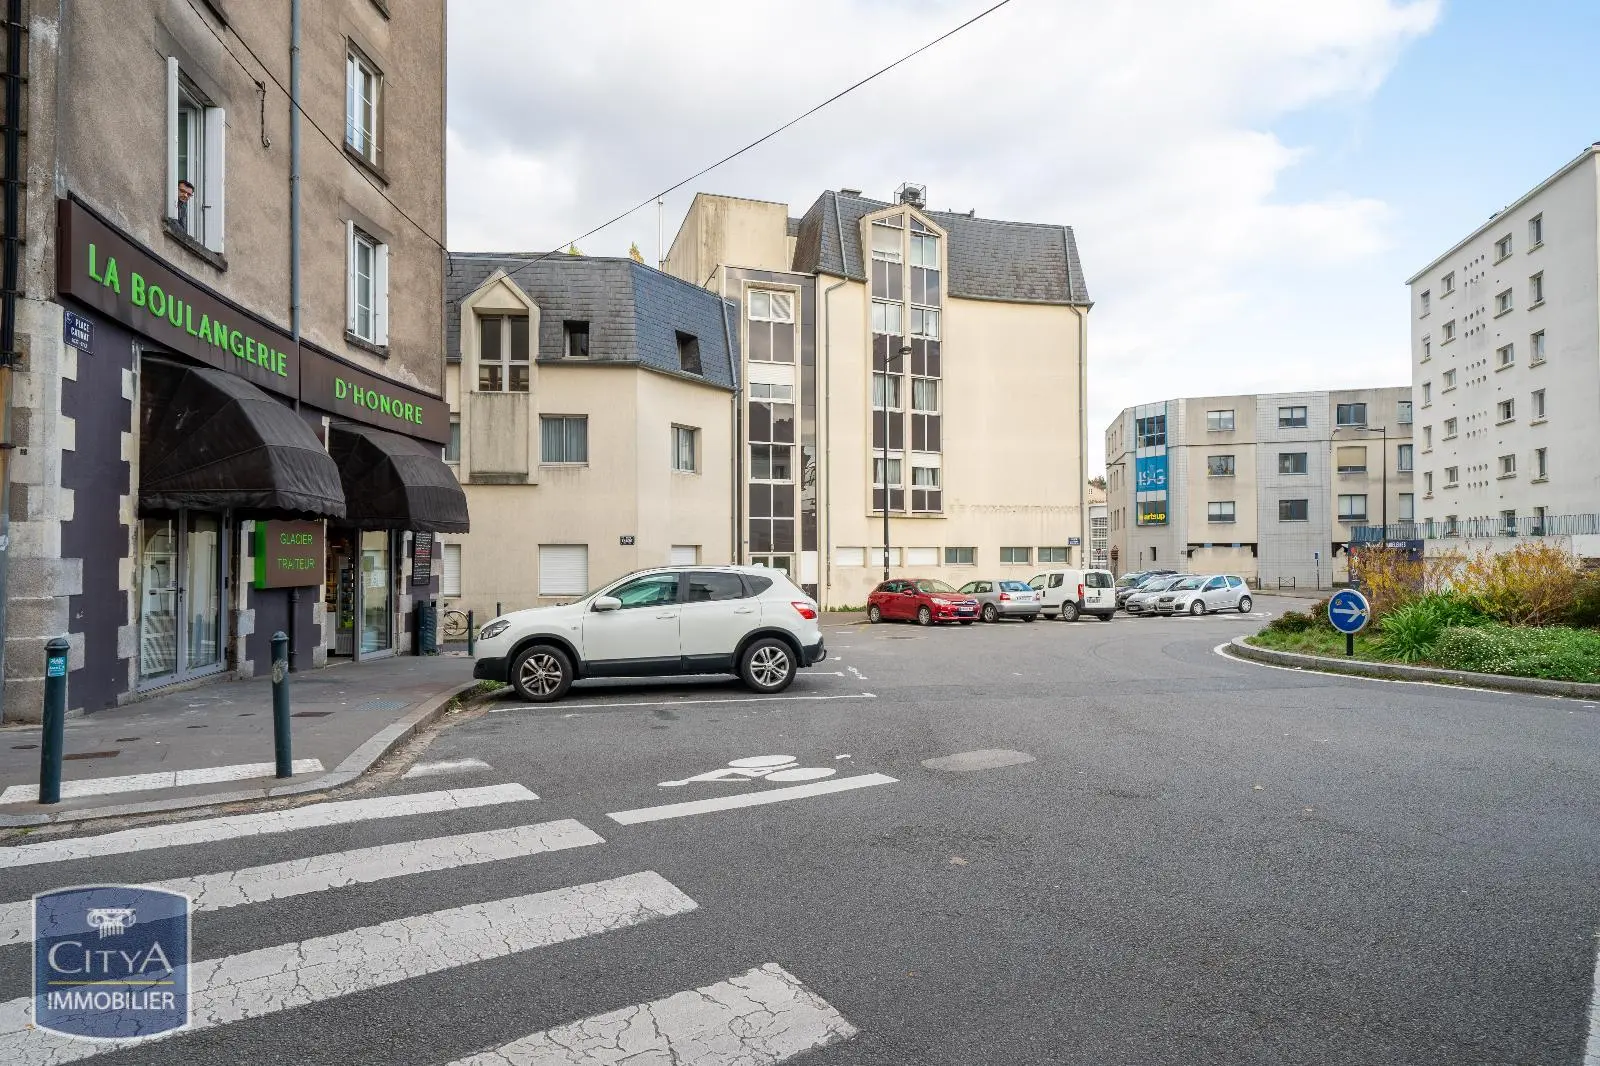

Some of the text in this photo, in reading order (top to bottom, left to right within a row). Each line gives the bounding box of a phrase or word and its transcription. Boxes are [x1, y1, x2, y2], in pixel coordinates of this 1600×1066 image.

[89, 244, 288, 377] LA BOULANGERIE
[335, 377, 423, 425] D'HONORE
[280, 532, 313, 545] GLACIER
[277, 558, 316, 570] TRAITEUR
